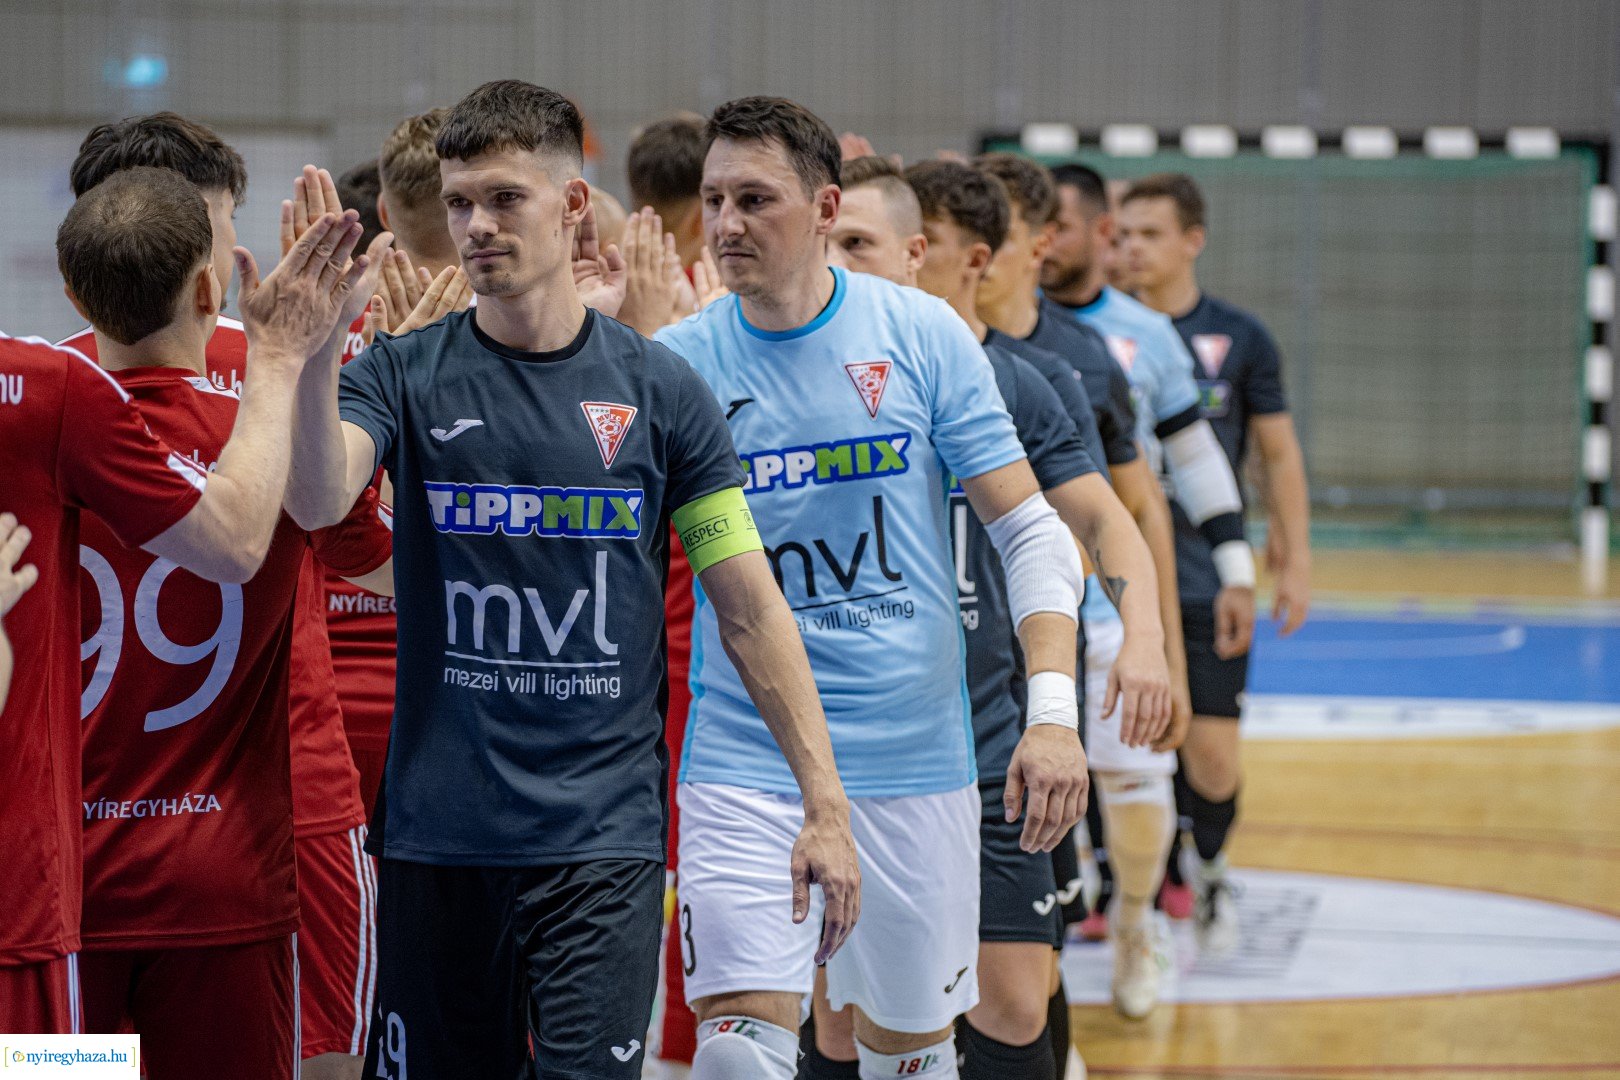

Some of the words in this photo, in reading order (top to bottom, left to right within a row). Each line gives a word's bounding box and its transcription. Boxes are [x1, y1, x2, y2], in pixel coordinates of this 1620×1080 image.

[684, 517, 730, 549] RESPECT
[445, 551, 619, 656] mvl
[814, 611, 841, 632] vill
[846, 600, 915, 628] lighting
[444, 665, 499, 690] mezei
[506, 672, 536, 694] vill
[544, 672, 621, 699] lighting
